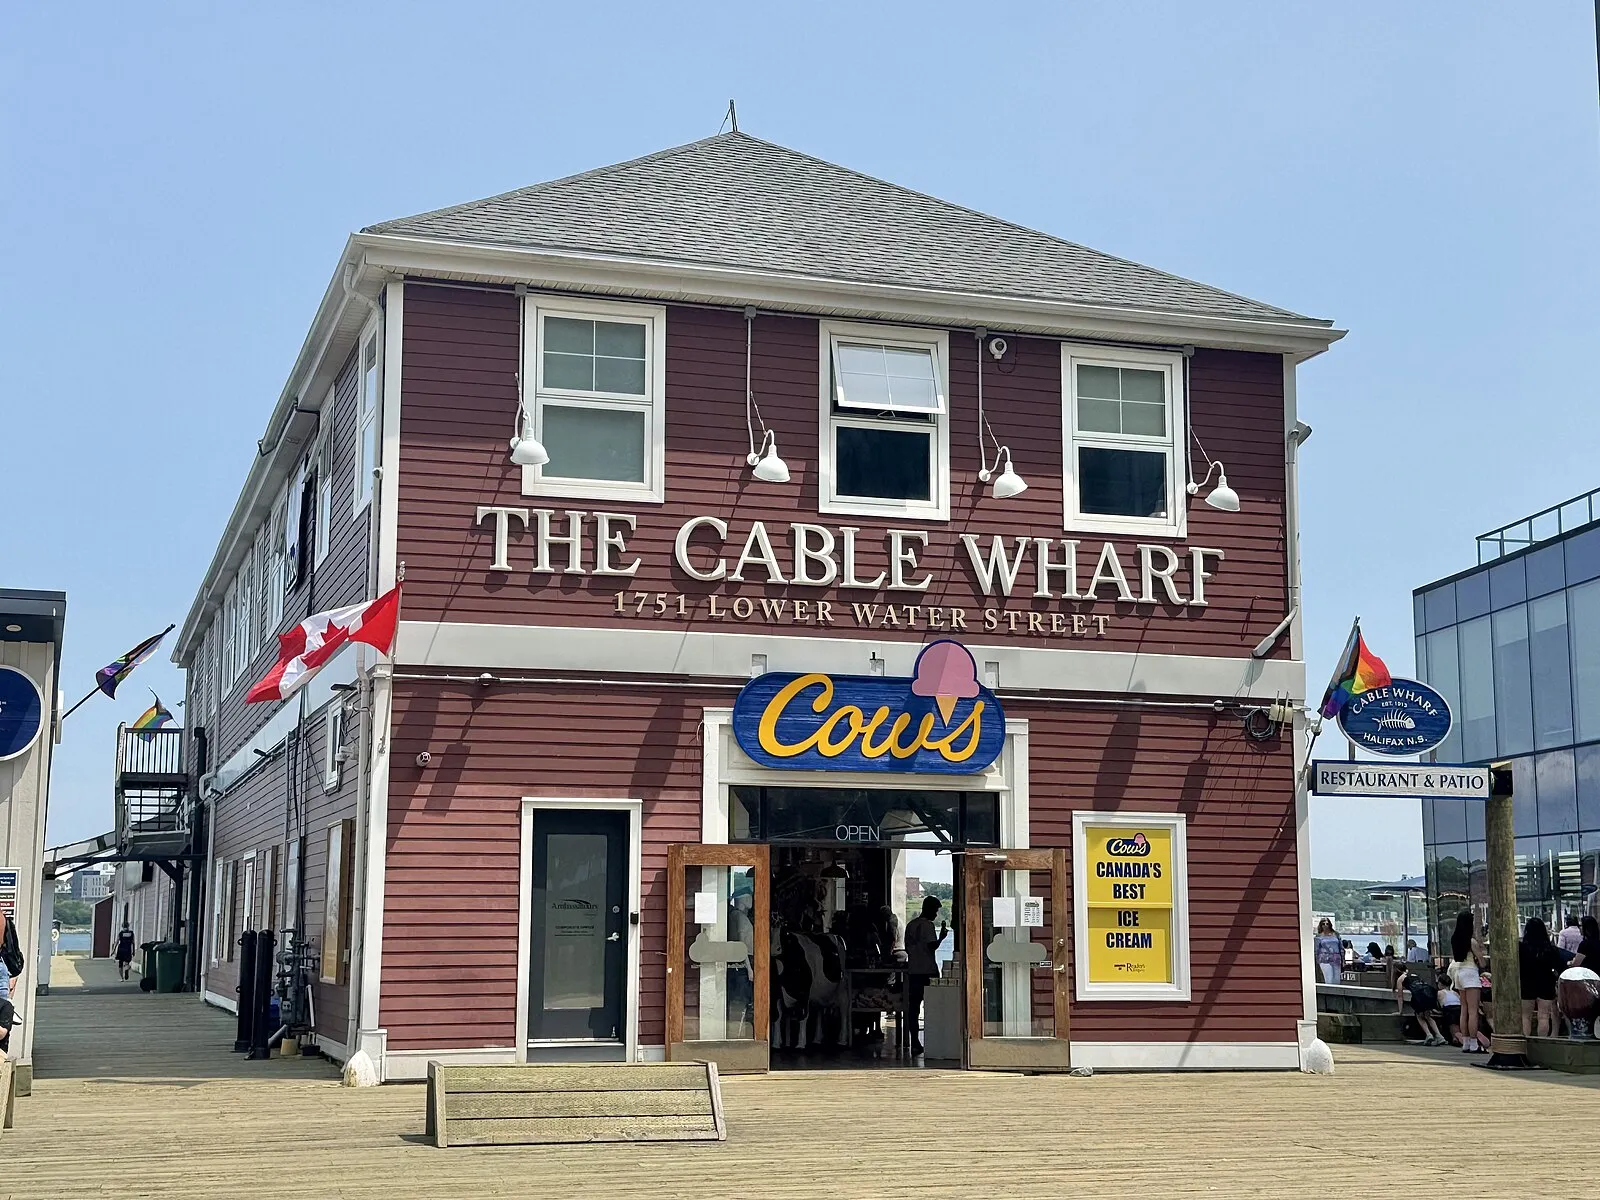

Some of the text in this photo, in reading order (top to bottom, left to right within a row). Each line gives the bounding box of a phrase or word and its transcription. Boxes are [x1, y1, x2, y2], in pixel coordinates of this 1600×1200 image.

[476, 506, 1225, 606] THE CABLE WHARF
[614, 591, 1110, 635] 1751 LOWER WATER STREET
[1352, 687, 1438, 717] CABLE WHARF
[1363, 732, 1428, 746] HALIFAX N.S.
[1321, 771, 1484, 789] RESTAURANT & PATIO
[835, 824, 880, 841] OPEN
[1096, 861, 1162, 879] CANADA'S
[1113, 883, 1146, 899] BEST
[1118, 910, 1139, 926] ICE
[1106, 932, 1152, 948] CREAM
